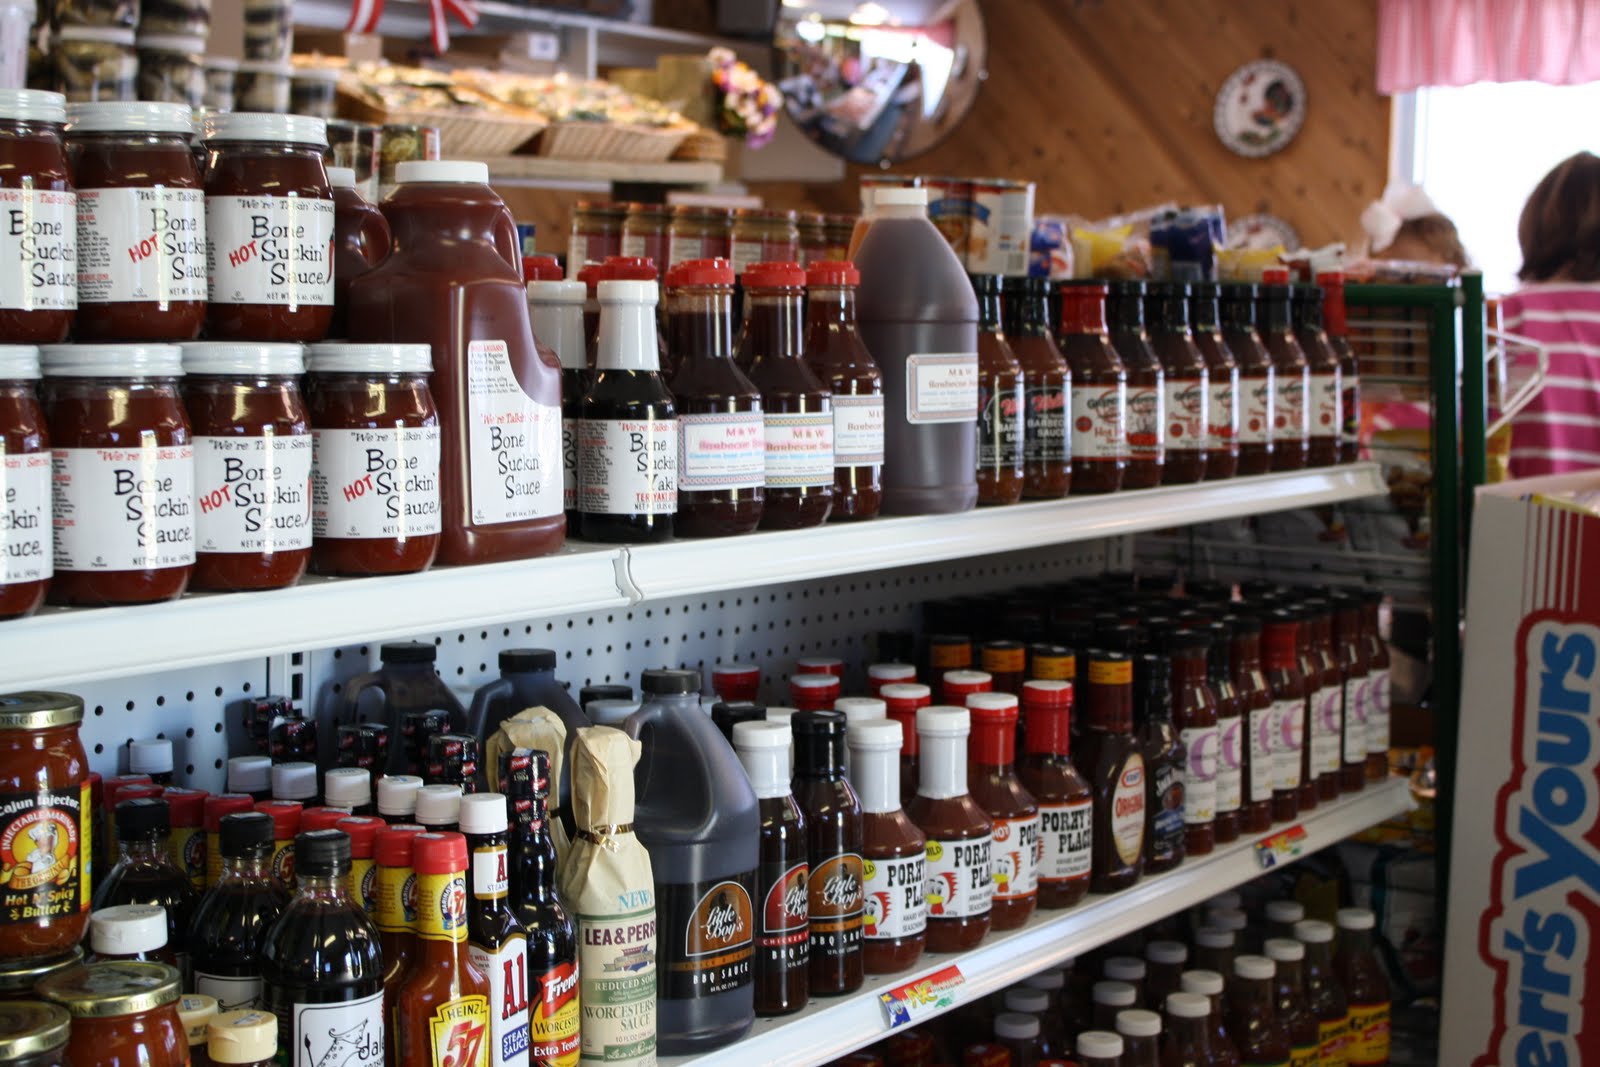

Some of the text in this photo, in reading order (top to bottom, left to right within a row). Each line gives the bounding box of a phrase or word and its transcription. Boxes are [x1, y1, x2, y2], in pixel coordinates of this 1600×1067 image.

[151, 208, 197, 232] Bone
[251, 216, 304, 239] Bone
[128, 234, 159, 263] HOT
[229, 240, 258, 268] HOT
[490, 426, 525, 451] Bone
[366, 449, 418, 472] Bone
[235, 483, 302, 507] Sukin'
[343, 474, 373, 503] HOT
[505, 475, 540, 499] Sauce
[636, 493, 667, 502] TERYAKI
[199, 484, 231, 514] HOT
[245, 507, 302, 532] Suce
[1513, 631, 1600, 899] Yours
[993, 826, 1010, 837] HOT
[5, 895, 28, 907] Hot
[48, 888, 75, 902] Spicy
[23, 903, 62, 918] Butter
[585, 928, 612, 946] LEA
[614, 927, 626, 945] &
[811, 936, 835, 946] BBQ
[772, 948, 794, 960] BBQ
[693, 961, 748, 985] BBQ SAUCE
[502, 952, 528, 1020] A1
[595, 979, 639, 991] REDUCED
[447, 1004, 480, 1020] HEINZ
[620, 1013, 651, 1032] SAUCE
[359, 1027, 384, 1060] dal
[443, 1020, 486, 1067] 57
[503, 1026, 528, 1048] STEAK
[503, 1039, 528, 1059] SAUCE
[534, 1046, 559, 1057] Extra
